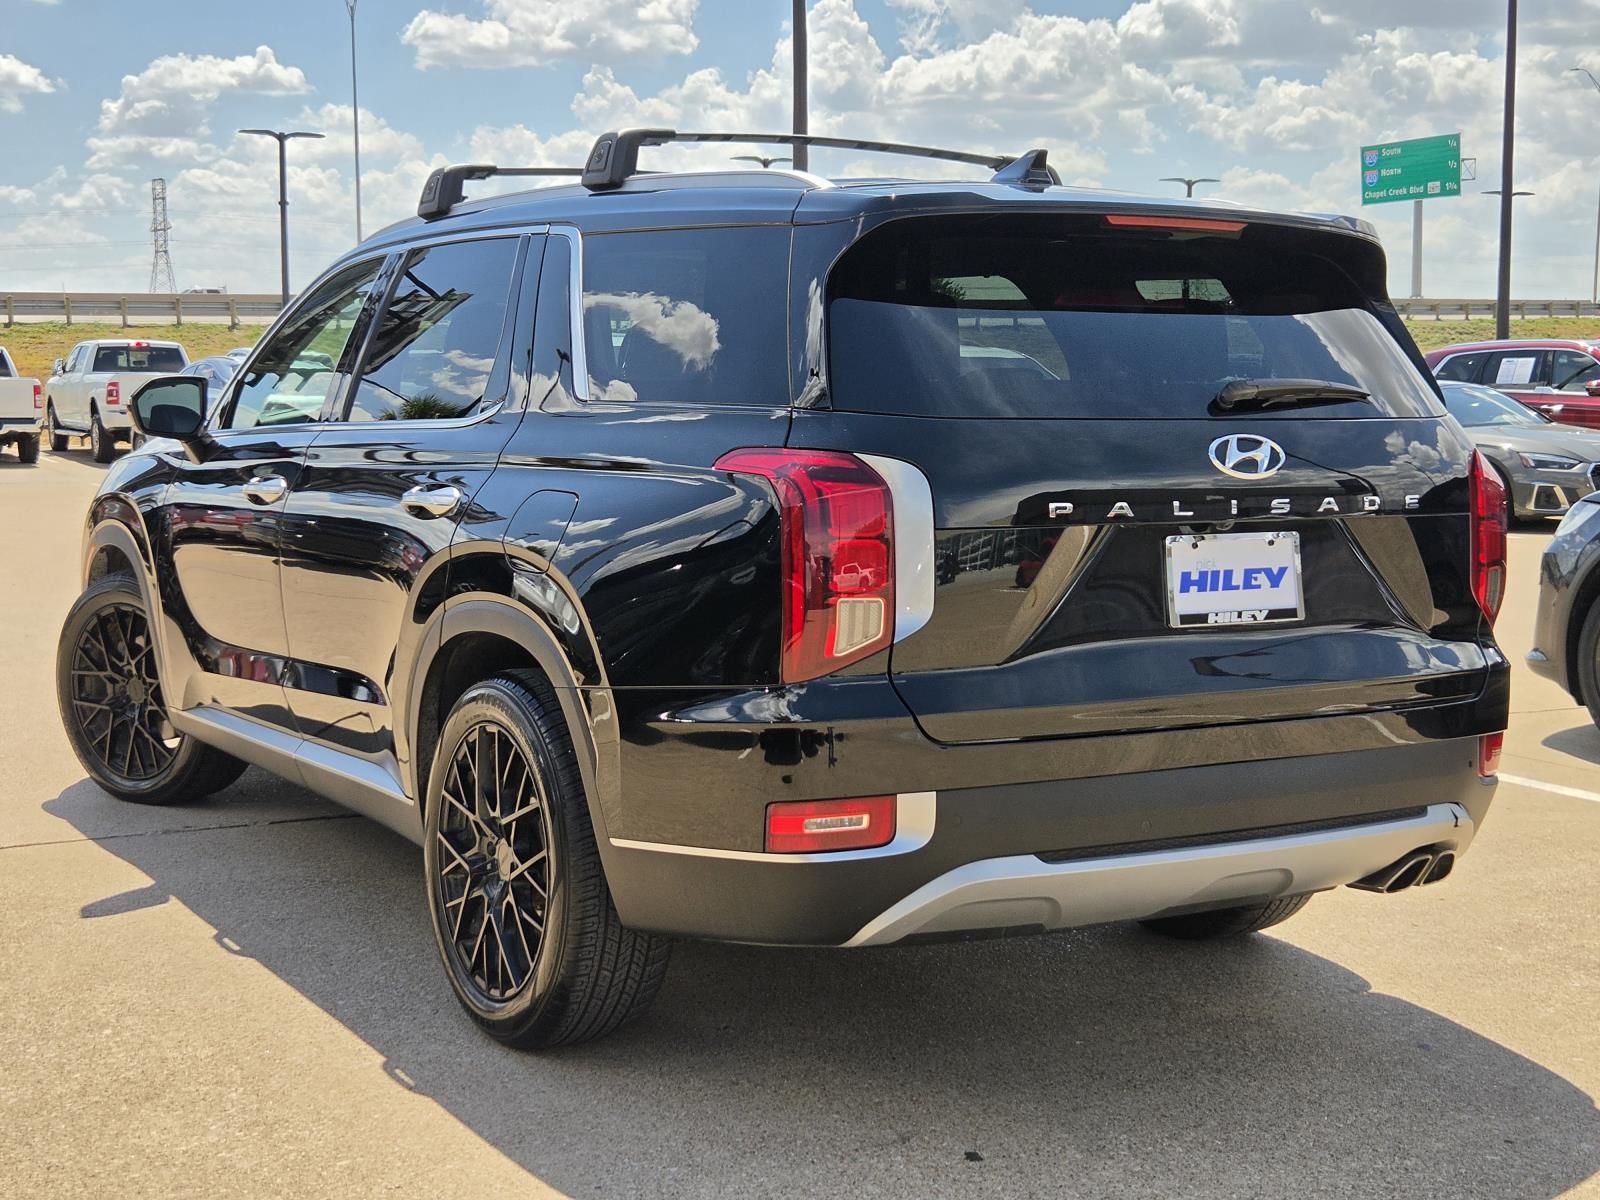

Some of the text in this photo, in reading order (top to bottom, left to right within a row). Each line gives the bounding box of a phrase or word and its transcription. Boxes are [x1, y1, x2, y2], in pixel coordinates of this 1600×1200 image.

[1364, 189, 1387, 199] Chapel
[1388, 187, 1407, 196] Creek
[1409, 185, 1424, 194] Blvd
[1047, 493, 1421, 519] PALISADE
[1179, 566, 1289, 594] HILEY
[1207, 609, 1270, 624] HILEY
